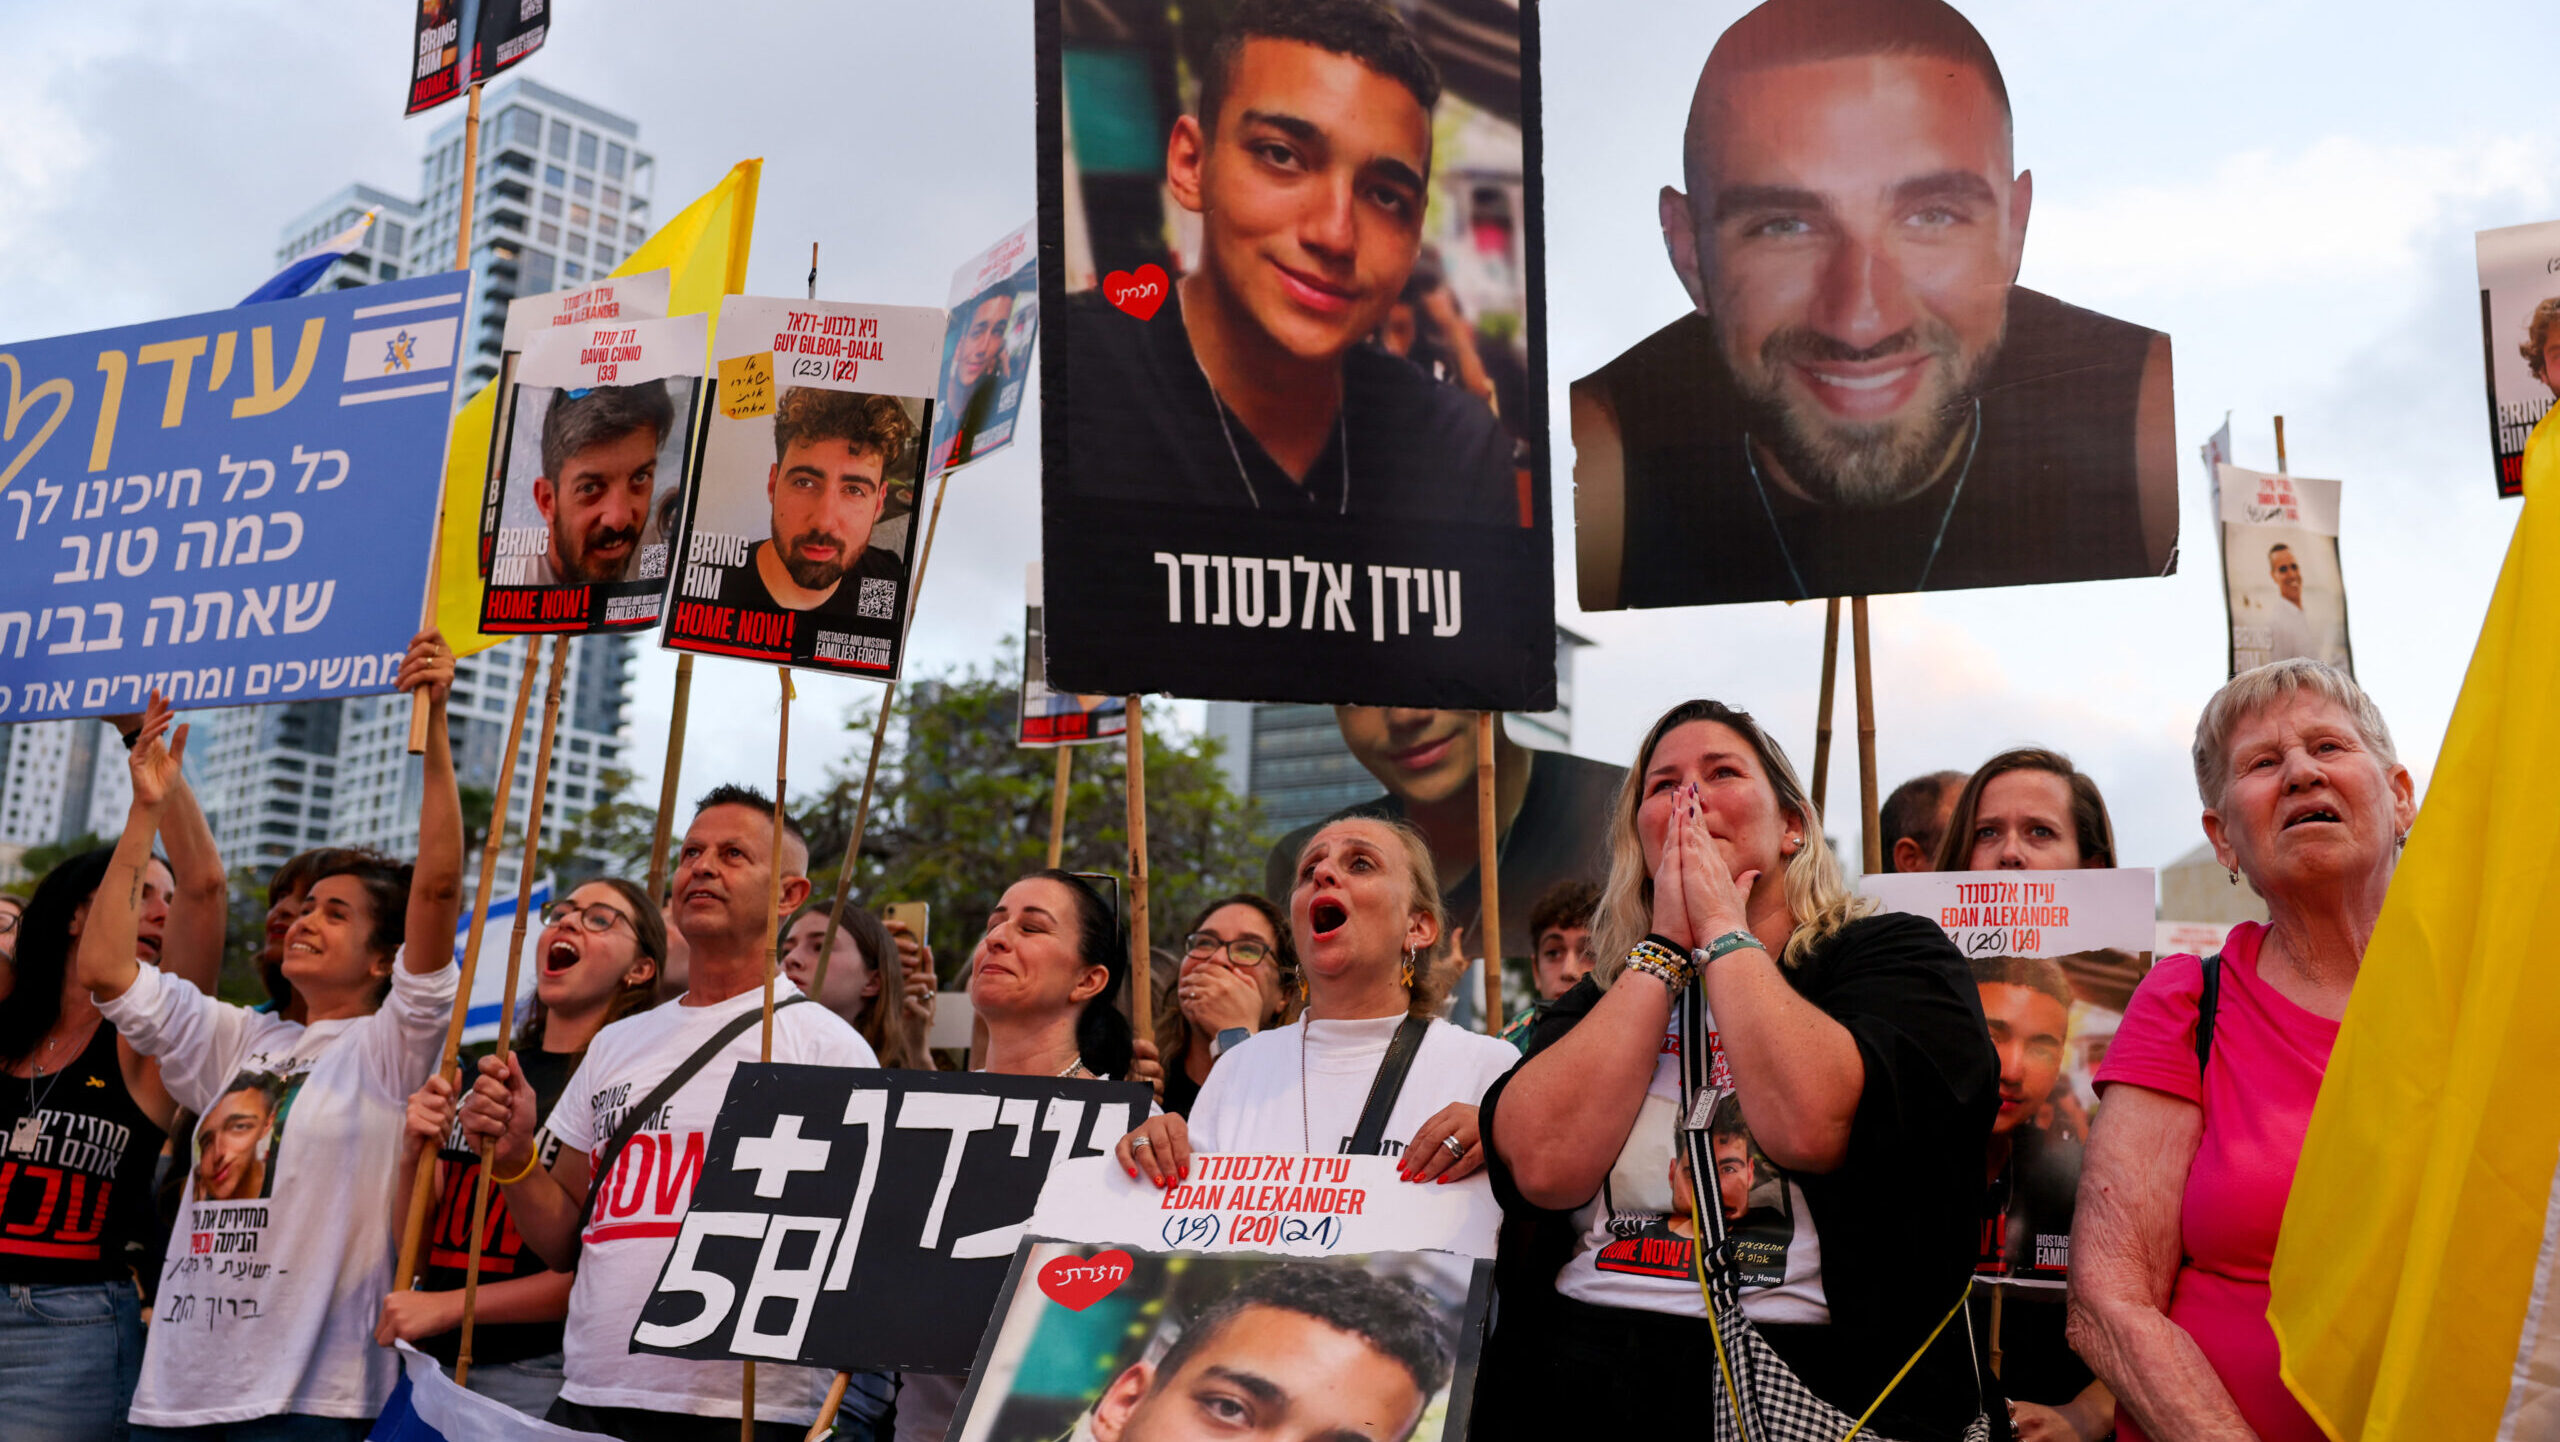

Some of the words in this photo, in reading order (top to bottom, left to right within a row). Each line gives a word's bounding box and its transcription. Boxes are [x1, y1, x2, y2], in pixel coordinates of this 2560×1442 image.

[420, 18, 457, 57] BRING
[417, 48, 443, 79] HIM
[413, 68, 451, 103] HOME
[620, 329, 637, 345] דוד
[787, 311, 856, 337] גלבוע-דלאל
[858, 318, 878, 339] גיא
[580, 348, 608, 366] DAVID
[610, 345, 642, 362] CUNIO
[774, 333, 797, 352] GUY
[799, 335, 884, 361] GILBOA-DALAL
[597, 365, 617, 383] (33)
[792, 358, 831, 382] (23)
[88, 317, 326, 473] עידן
[218, 455, 276, 502] כל
[292, 445, 349, 493] כל
[8, 478, 63, 541] לך
[72, 467, 202, 521] חיכינו
[53, 526, 159, 584] טוב
[174, 511, 304, 572] כמה
[496, 527, 549, 555] BRING
[689, 530, 750, 568] BRING
[491, 557, 528, 586] HIM
[682, 565, 722, 600] HIM
[486, 590, 538, 619] HOME
[540, 585, 591, 619] NOW!
[1154, 552, 1356, 632] אלכסנדר
[1367, 565, 1462, 642] עידן
[142, 580, 336, 646] שאתה
[674, 602, 735, 640] HOME
[737, 610, 796, 648] NOW!
[816, 641, 856, 661] FAMILIES
[857, 647, 890, 666] FORUM
[817, 630, 849, 645] HOSTAGES
[849, 634, 863, 646] AND
[863, 636, 891, 650] MISSING
[82, 666, 236, 709] ומחזירים
[244, 651, 407, 696] ממשיכים
[19, 680, 75, 713] את
[1956, 882, 2018, 904] אלכסנדר
[2023, 883, 2055, 905] עידן
[1941, 907, 1979, 928] EDAN
[1982, 906, 2070, 928] ALEXANDER
[59, 1138, 120, 1178] אותם
[1199, 1155, 1294, 1181] אלכסנדר
[1299, 1158, 1351, 1184] עידן
[1161, 1185, 1225, 1210] EDAN
[1227, 1186, 1366, 1215] ALEXANDER
[218, 1207, 268, 1229] מחזירים
[1229, 1214, 1279, 1246] (20)
[1280, 1215, 1341, 1250] (21)
[214, 1231, 257, 1253] הביתה
[1601, 1238, 1641, 1261] HOME
[1640, 1237, 1692, 1268] NOW!
[2036, 1234, 2069, 1247] HOSTAG
[634, 1211, 841, 1360] 58
[1054, 1264, 1123, 1287] חזרתי
